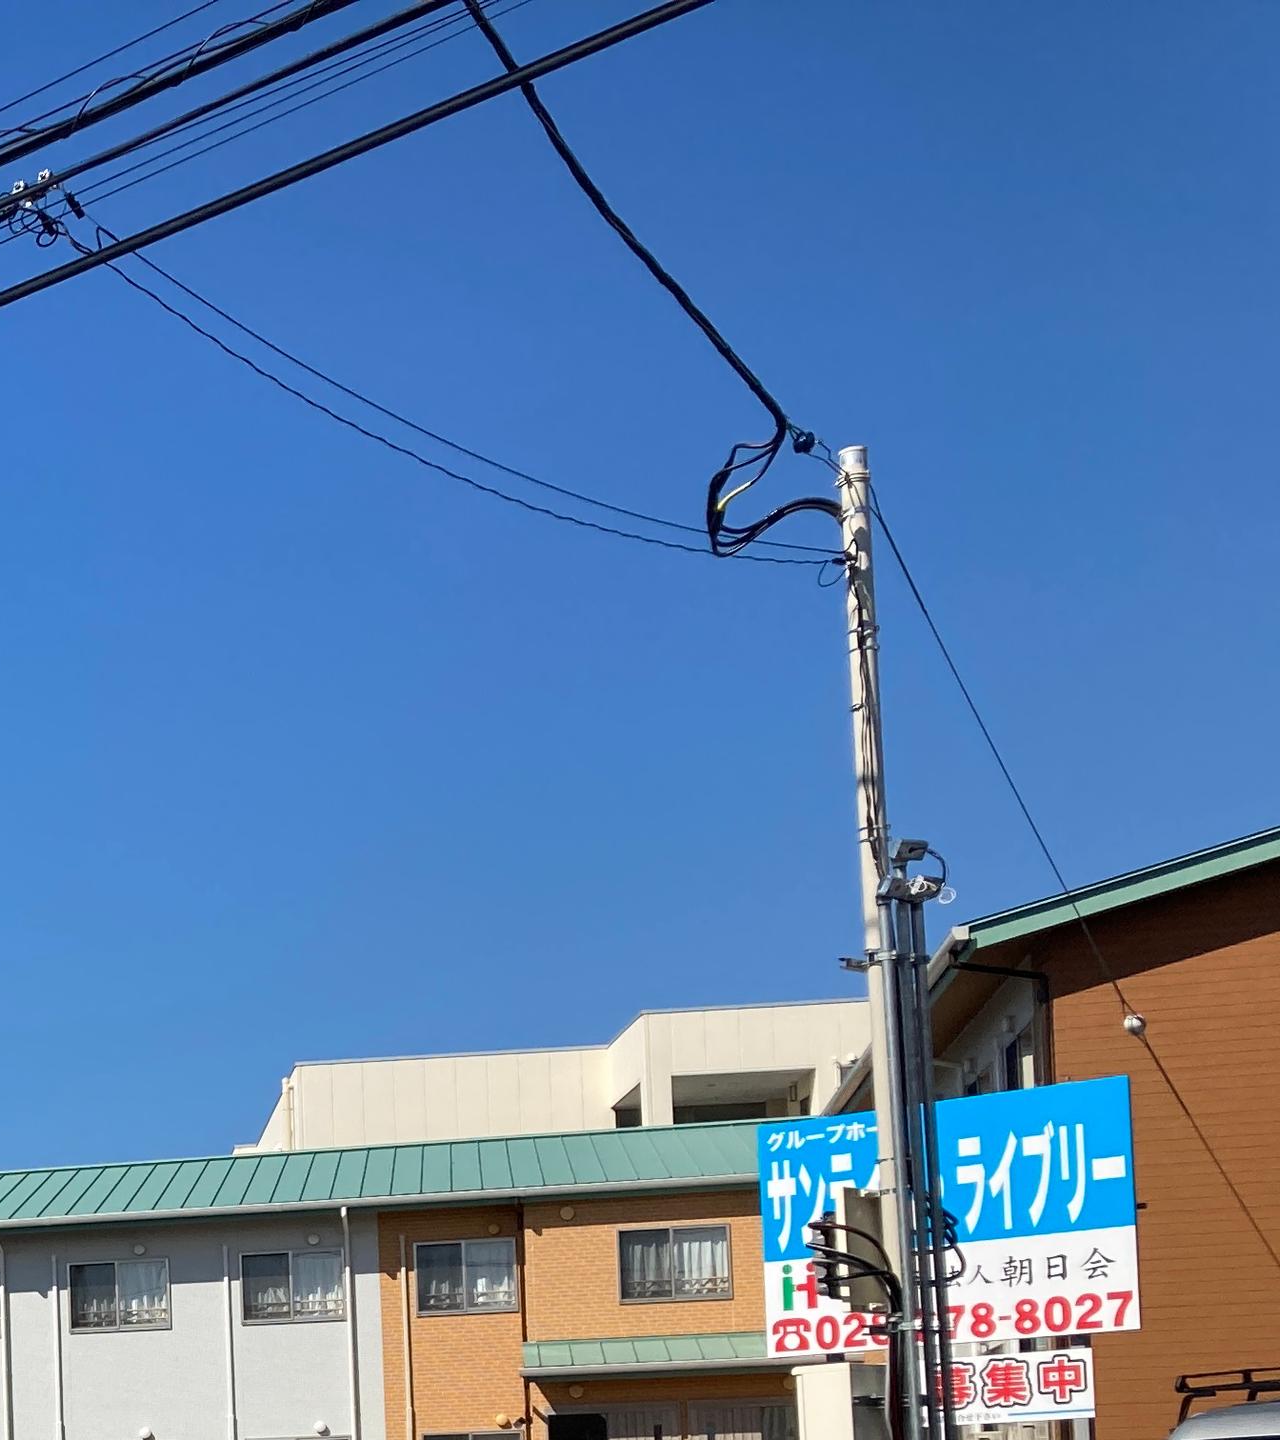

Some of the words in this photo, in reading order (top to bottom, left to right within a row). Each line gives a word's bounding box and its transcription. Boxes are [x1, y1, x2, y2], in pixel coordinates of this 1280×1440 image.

[766, 1121, 878, 1152] グループホー
[815, 1290, 1134, 1351] 02878-8027
